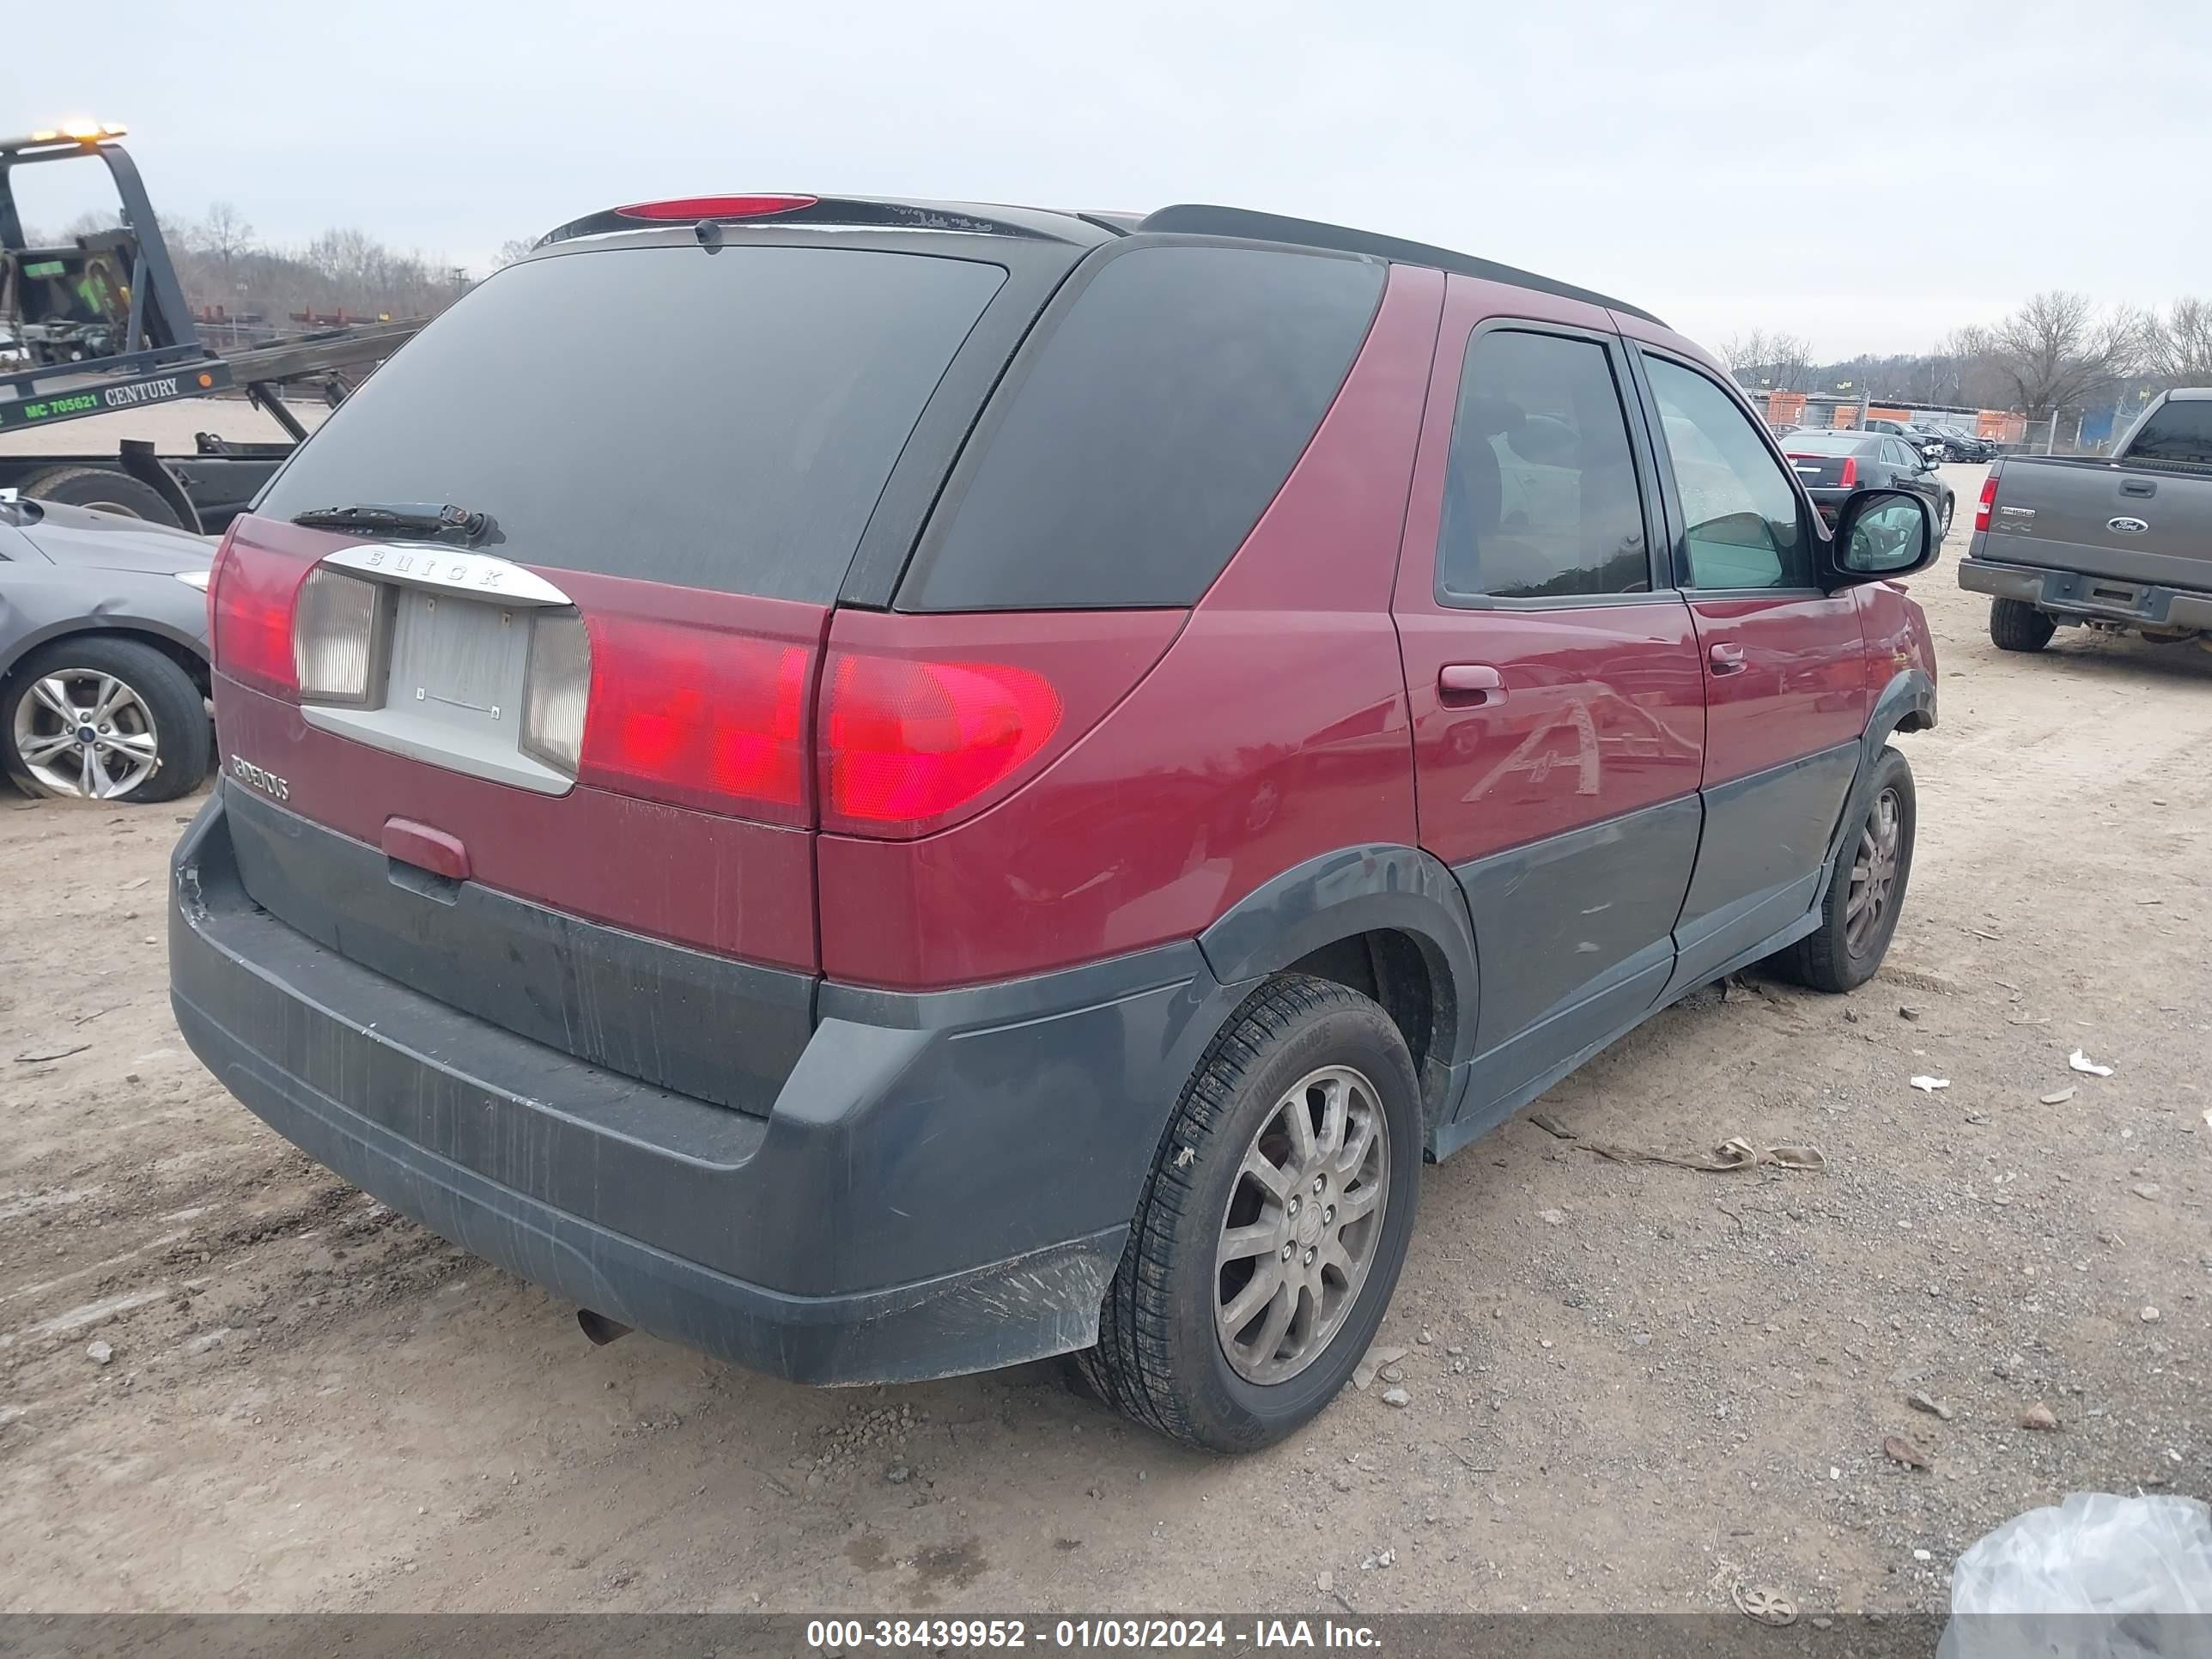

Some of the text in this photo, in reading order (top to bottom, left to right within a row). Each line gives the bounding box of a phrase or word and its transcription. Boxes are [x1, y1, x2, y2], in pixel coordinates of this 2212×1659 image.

[25, 394, 98, 419] MC 705621
[105, 378, 179, 407] CENTURY
[366, 550, 503, 586] BUICK
